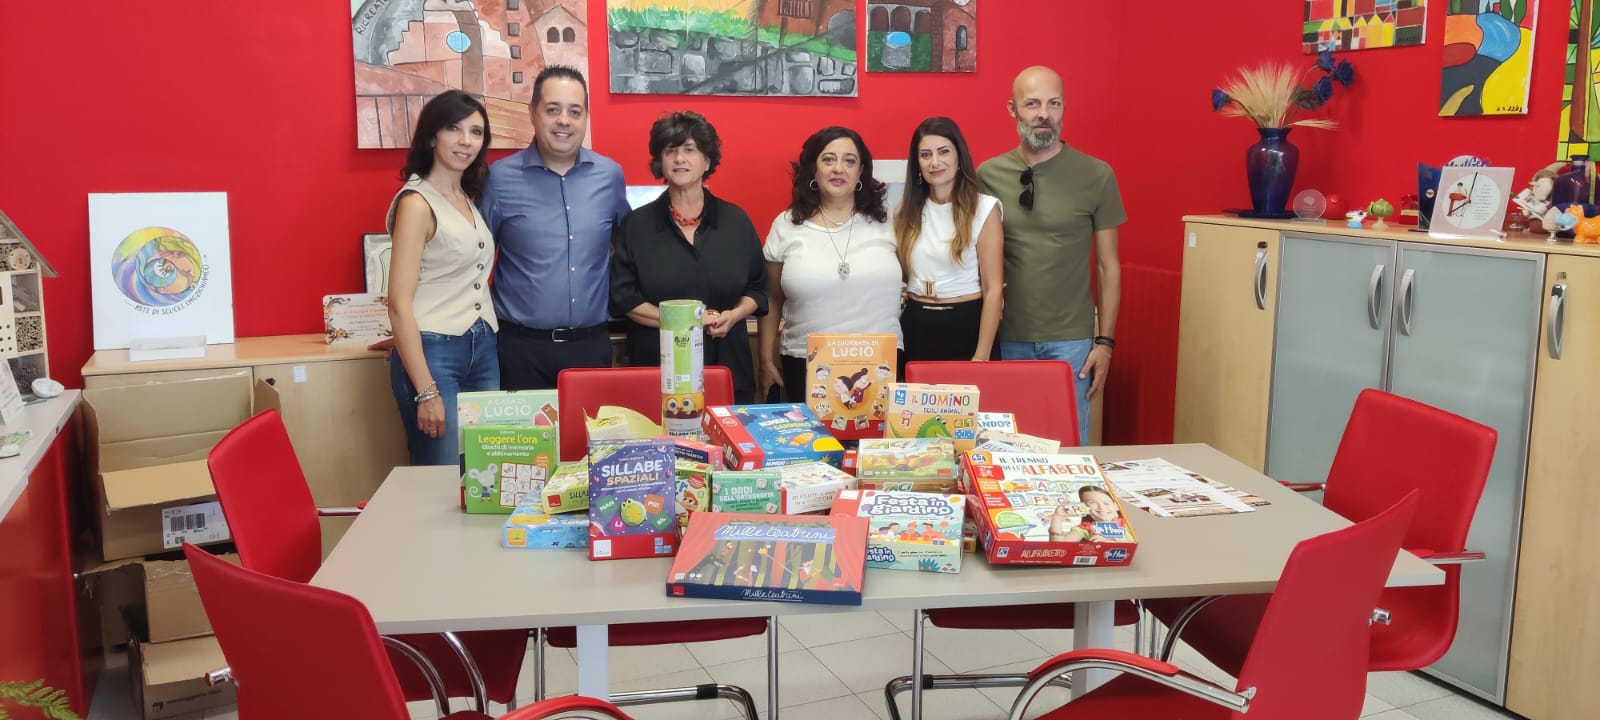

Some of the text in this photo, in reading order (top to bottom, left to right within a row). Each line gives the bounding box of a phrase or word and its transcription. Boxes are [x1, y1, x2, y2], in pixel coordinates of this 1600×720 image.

[355, 0, 388, 34] RICREAT
[832, 346, 874, 358] LUCIO
[484, 405, 531, 418] LUCIO
[478, 434, 538, 445] Leggere l'ora
[601, 460, 664, 478] SILLABE
[606, 472, 659, 486] SPAZIALI
[877, 496, 945, 506] Festa in
[871, 503, 951, 515] giardino
[717, 525, 836, 540] Mille teatrini
[867, 547, 884, 555] sta
[867, 554, 895, 562] ardino
